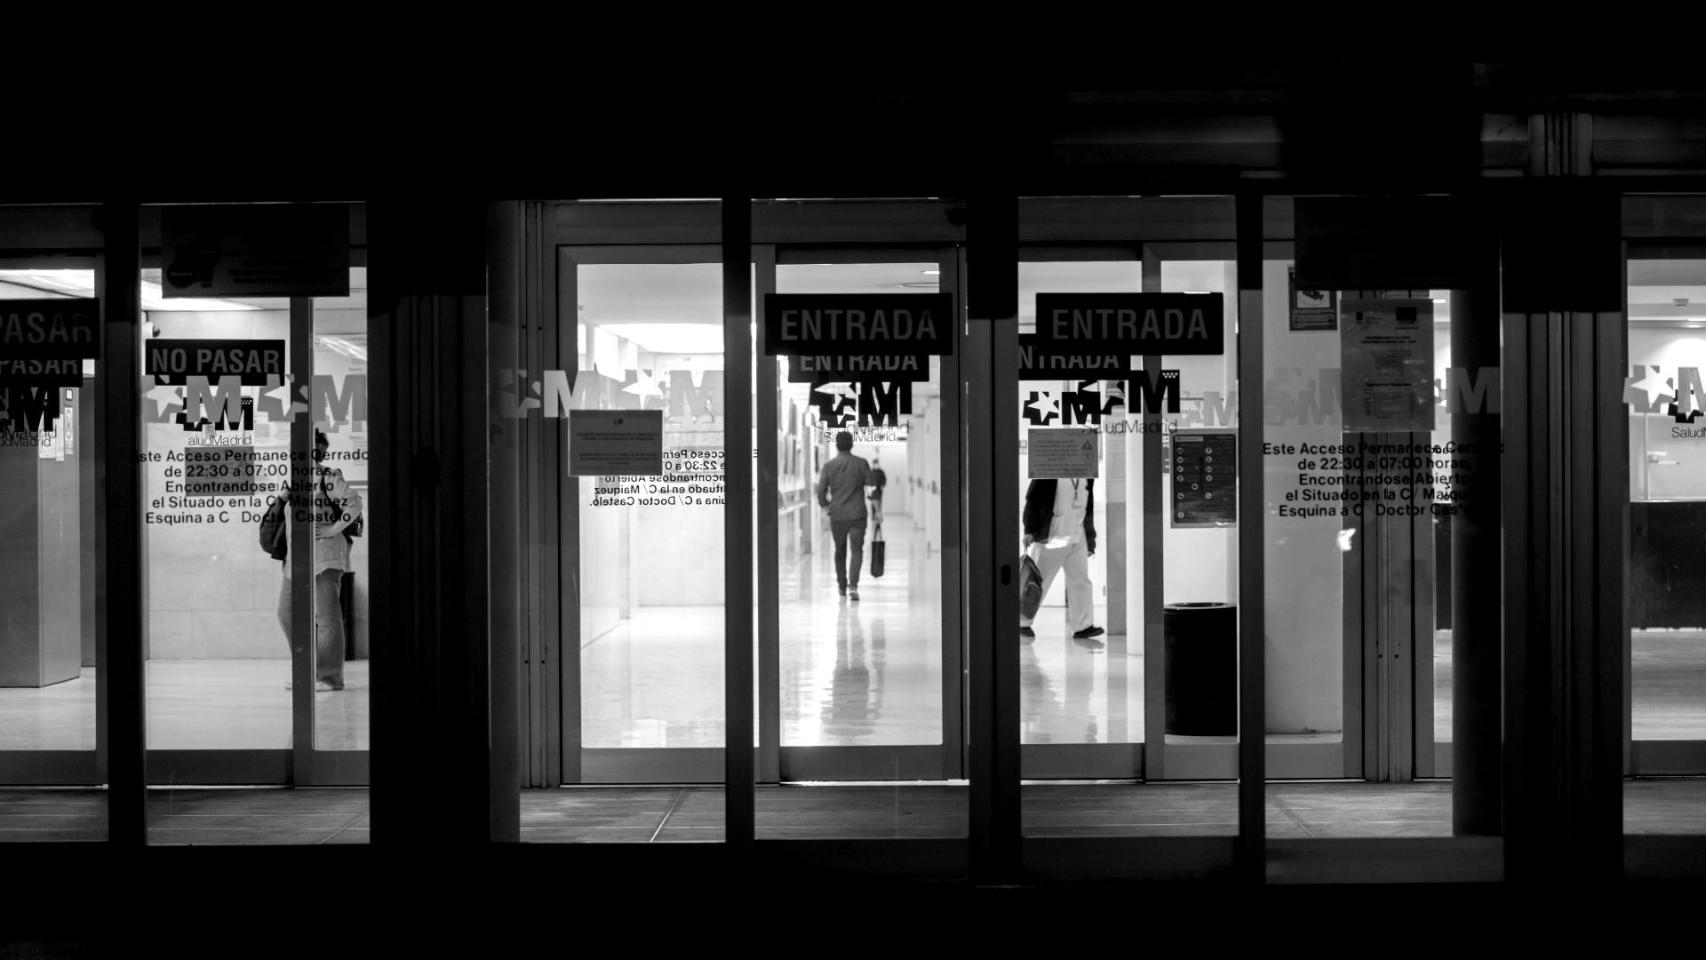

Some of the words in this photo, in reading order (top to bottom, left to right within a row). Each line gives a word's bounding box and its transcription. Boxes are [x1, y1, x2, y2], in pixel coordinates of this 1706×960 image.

[0, 312, 93, 344] ASAR
[779, 309, 938, 341] ENTRADA
[1051, 308, 1209, 341] ENTRADA
[151, 348, 188, 374] NO
[196, 347, 281, 374] PASAR
[166, 450, 221, 462] Acceso
[224, 449, 306, 461] Permanece
[1262, 442, 1295, 455] Este
[1300, 442, 1355, 455] Acceso
[1297, 458, 1316, 470] de
[1320, 457, 1363, 470] 22:30
[1367, 460, 1376, 470] a
[1379, 456, 1423, 470] 07:00
[164, 466, 182, 477] de
[186, 464, 228, 477] 22:30
[233, 467, 241, 477] a
[245, 464, 288, 477] 07:00
[165, 480, 276, 493] Encontrandose
[1299, 473, 1411, 486] Encontrandose
[1285, 489, 1298, 501] el
[1302, 488, 1359, 501] Situado
[1362, 491, 1380, 501] en
[1383, 488, 1396, 500] la
[152, 496, 165, 508] el
[168, 495, 225, 509] Situado
[228, 498, 246, 508] en
[249, 495, 261, 508] la
[1279, 504, 1336, 519] Esquina
[1341, 507, 1349, 517] a
[1375, 503, 1425, 517] Doctor
[145, 511, 202, 526] Esquina
[206, 513, 215, 524] a
